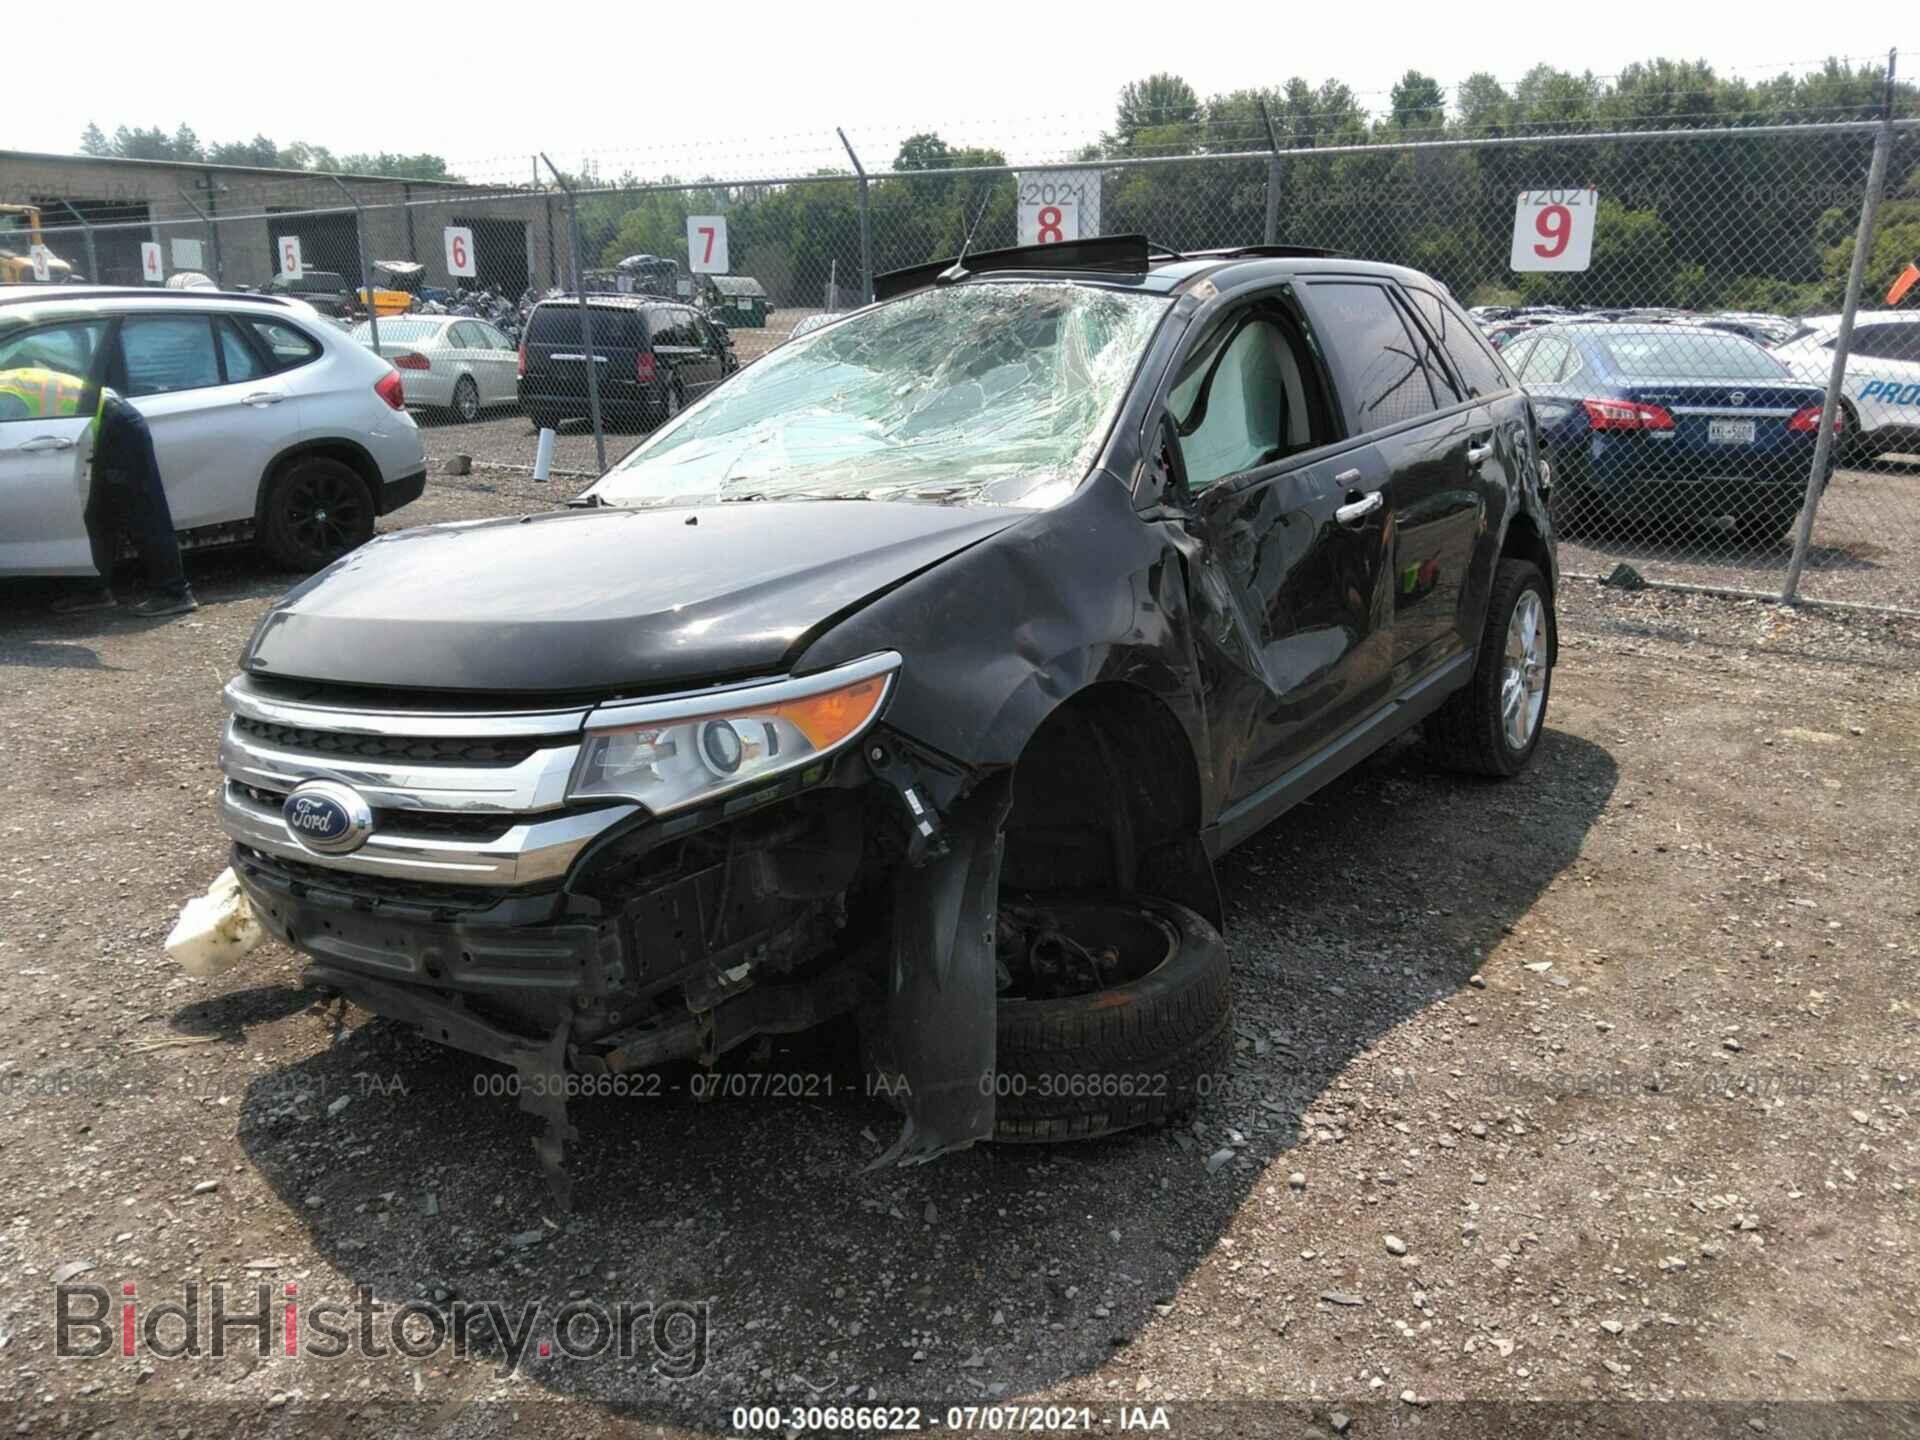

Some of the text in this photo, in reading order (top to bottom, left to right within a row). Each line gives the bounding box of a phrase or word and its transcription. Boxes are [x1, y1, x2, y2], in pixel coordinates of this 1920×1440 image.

[1038, 206, 1063, 244] 8
[1533, 204, 1572, 259] 9
[147, 248, 157, 274] 4
[285, 244, 297, 272] 5
[452, 235, 467, 269] 6
[697, 226, 715, 264] 7
[1857, 380, 1920, 407] PRO
[291, 797, 333, 833] Ford
